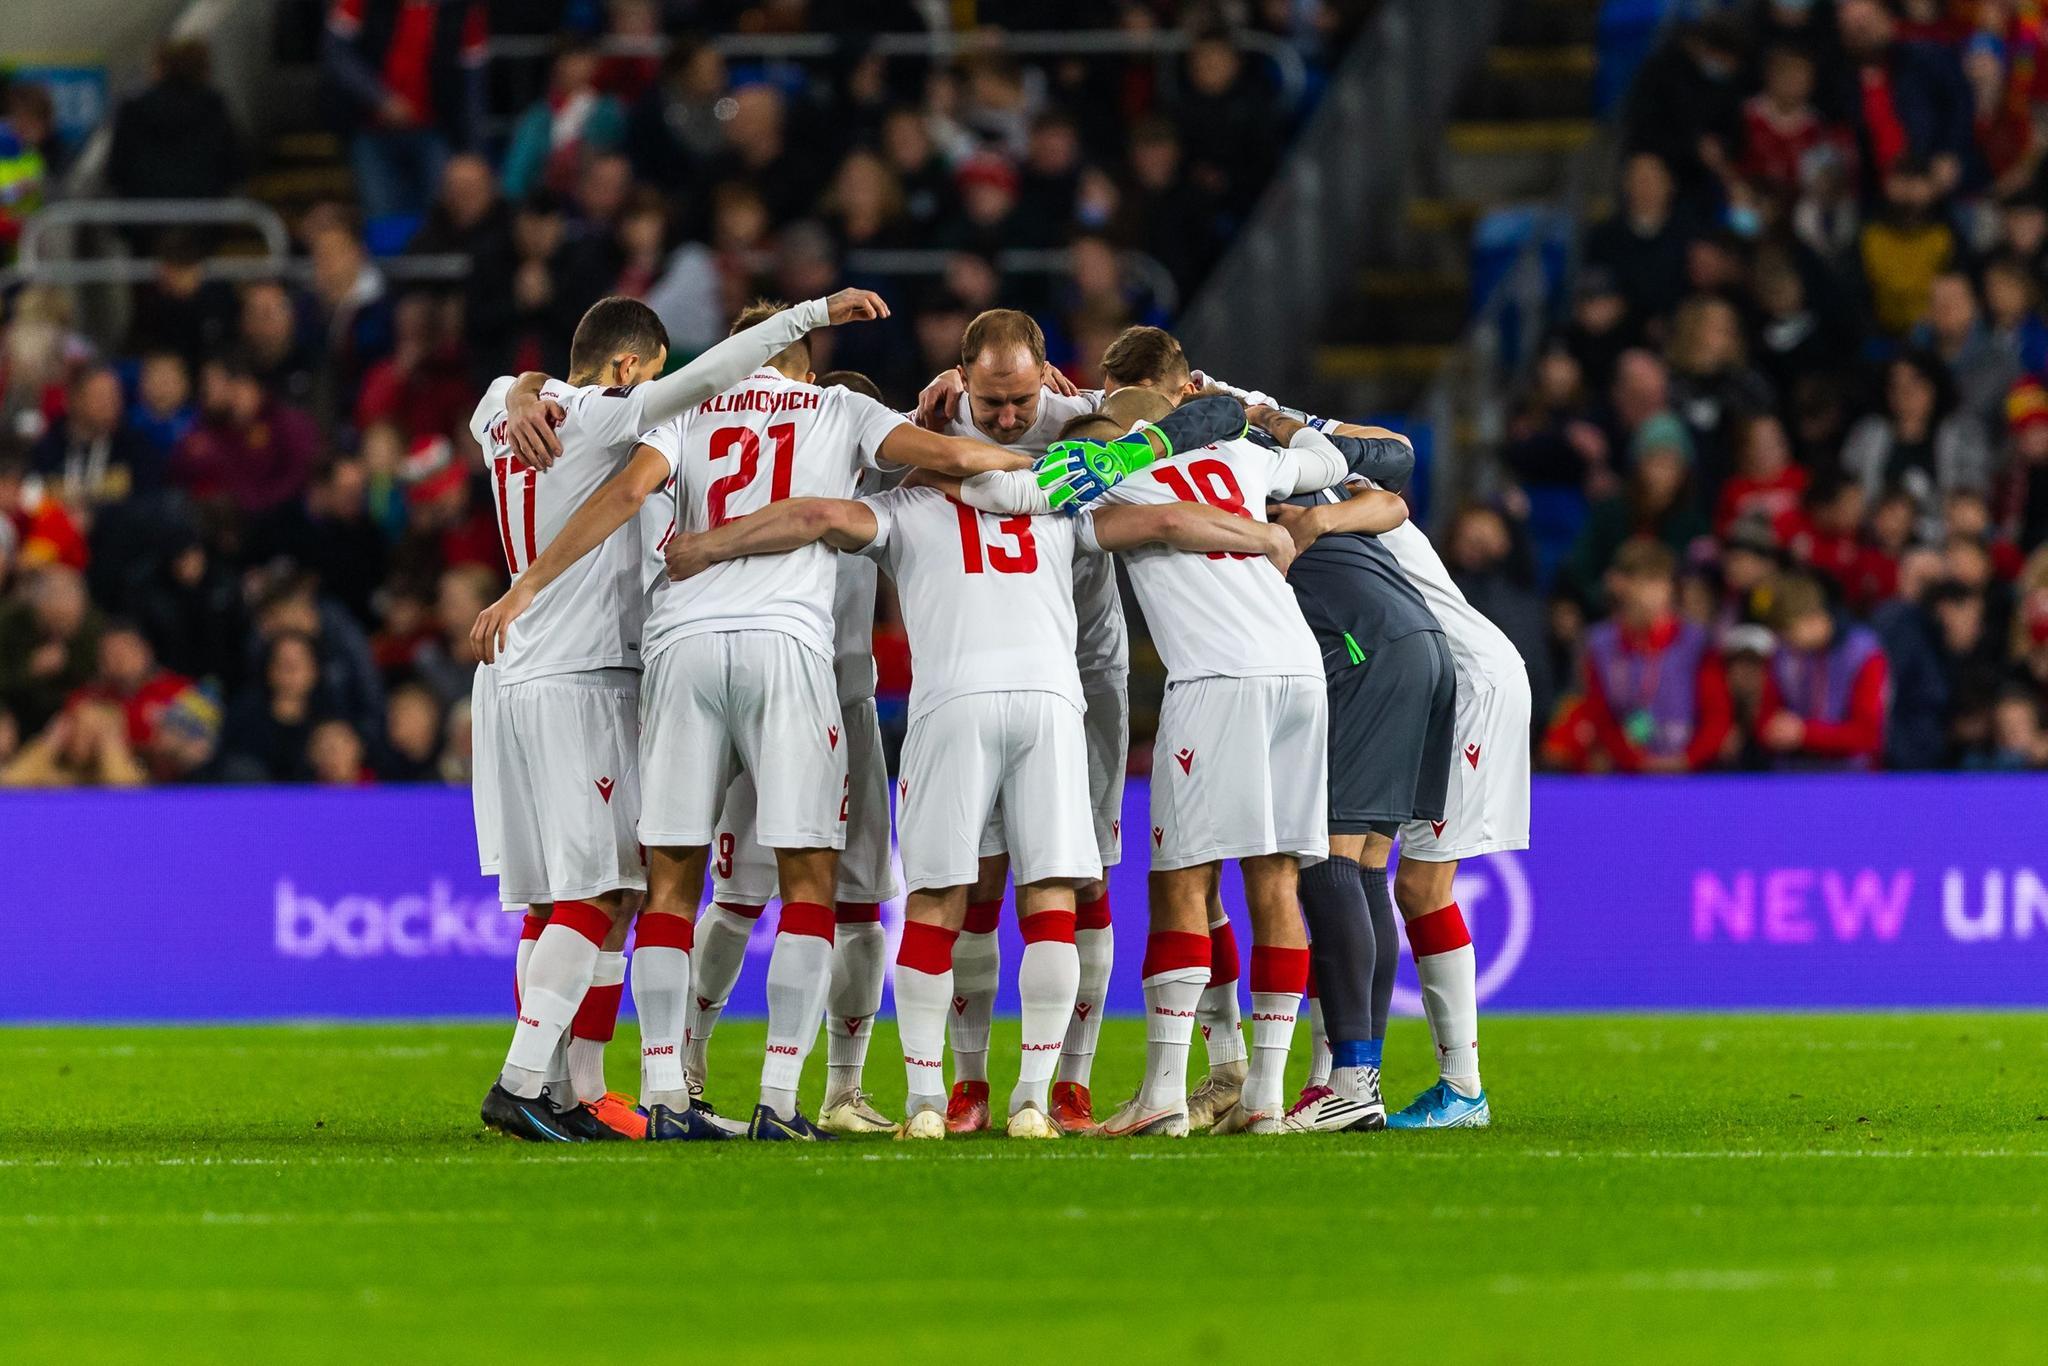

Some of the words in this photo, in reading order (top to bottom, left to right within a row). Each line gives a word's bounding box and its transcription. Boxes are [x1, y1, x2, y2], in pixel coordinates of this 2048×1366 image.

[699, 389, 819, 415] KLIMOVICH
[707, 421, 796, 530] 21
[944, 494, 1039, 574] 13
[1692, 867, 1916, 943] NEW
